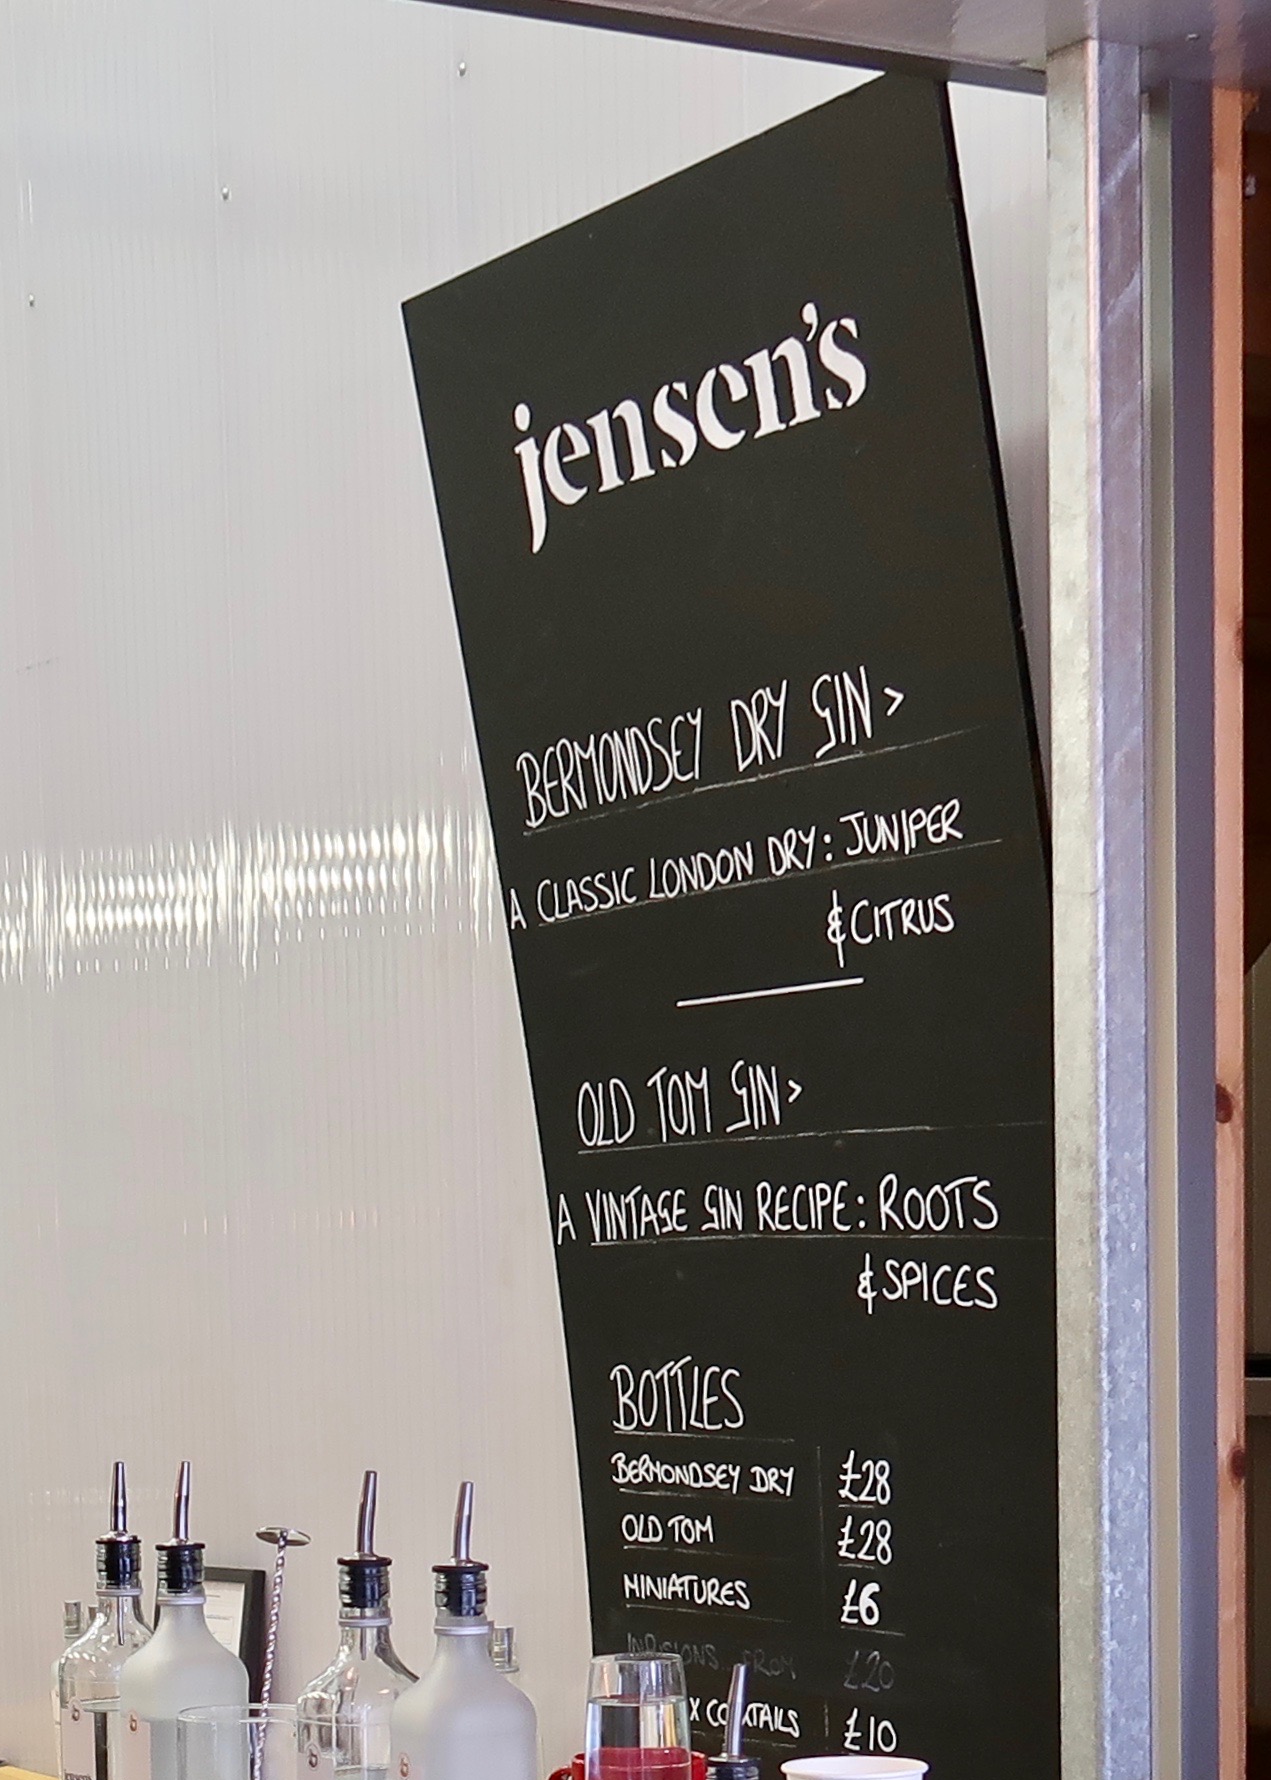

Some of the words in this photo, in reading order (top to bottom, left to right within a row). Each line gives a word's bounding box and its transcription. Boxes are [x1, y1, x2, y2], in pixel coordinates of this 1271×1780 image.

[514, 303, 867, 553] jensen's
[516, 708, 702, 828] BERMONDSEY
[731, 680, 788, 772] DRY
[812, 666, 872, 759] GIN
[510, 888, 527, 930] A
[537, 867, 636, 923] CLASSIC
[649, 841, 754, 899] LONDON
[840, 799, 964, 856] JUNIPER
[850, 893, 955, 946] CITRUS
[577, 1080, 635, 1146] OLD
[647, 1067, 712, 1143] TOM
[726, 1060, 781, 1133] GIN
[557, 1193, 577, 1246] A
[585, 1185, 688, 1243] VINTAGE
[701, 1184, 743, 1232] GIN
[879, 1174, 999, 1232] ROOTS
[883, 1259, 998, 1309] SPICES
[610, 1356, 744, 1431] BOTTLES
[611, 1452, 740, 1495] BERMONDSEY
[749, 1466, 795, 1497] DRY
[838, 1449, 891, 1504] £28
[622, 1514, 663, 1543] OLD
[667, 1515, 714, 1544] TOM
[838, 1516, 892, 1565] £28
[841, 1579, 881, 1626] £6
[843, 1707, 898, 1753] £10
